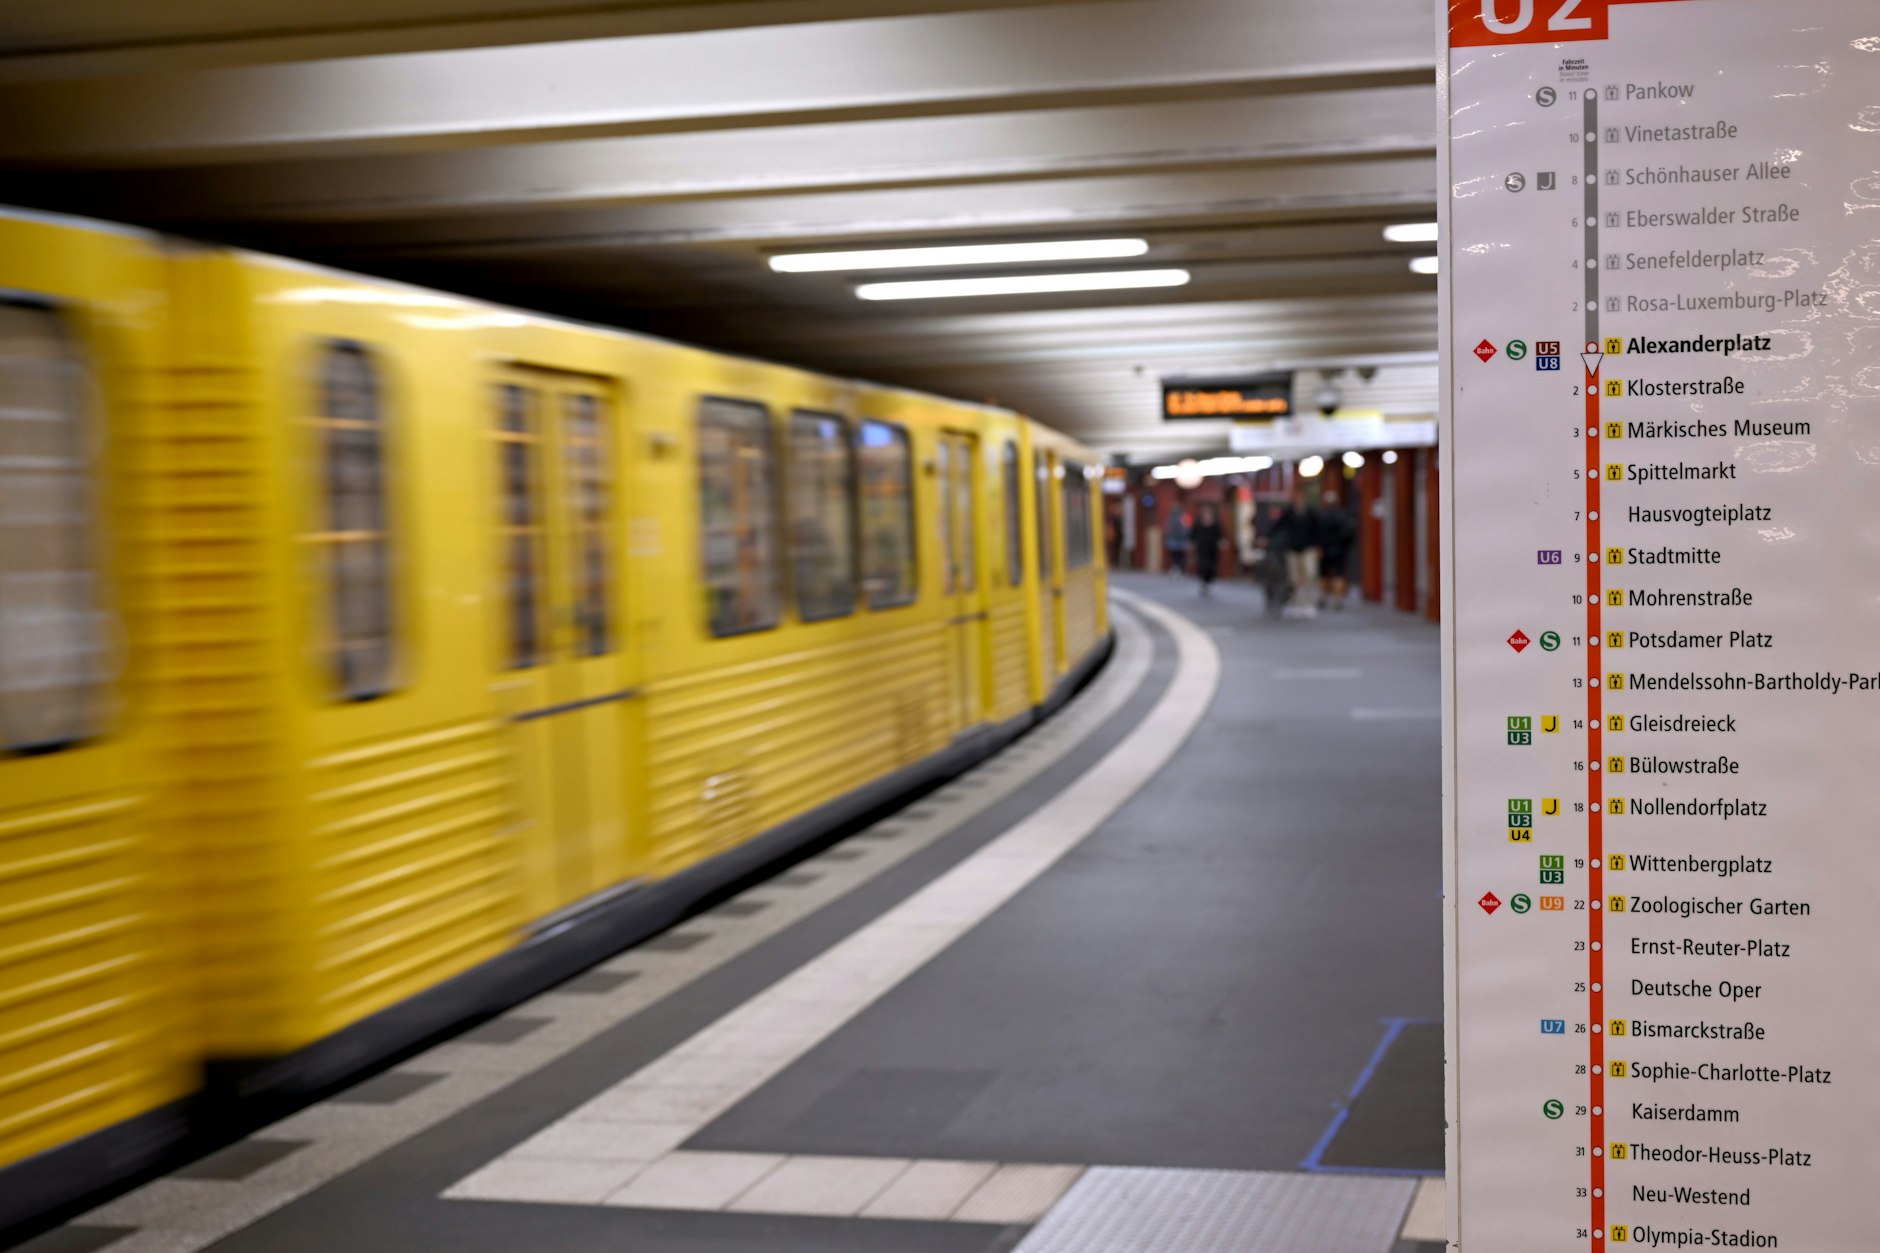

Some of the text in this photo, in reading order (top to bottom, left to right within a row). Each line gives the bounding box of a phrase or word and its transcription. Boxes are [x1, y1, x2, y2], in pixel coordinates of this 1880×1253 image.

[1569, 91, 1576, 100] 11
[1627, 81, 1694, 99] Pankow
[1625, 121, 1737, 142] Vinetastraße
[1569, 133, 1579, 143] 10
[1626, 162, 1790, 185] Schönhauser Allee
[1572, 176, 1577, 185] 8
[1628, 204, 1799, 227] Eberswalder Straße
[1572, 218, 1578, 227] 6
[1572, 260, 1578, 269] 4
[1627, 248, 1764, 271] Senefelderplatz
[1628, 289, 1827, 312] Rosa-Luxemburg-Platz
[1573, 302, 1578, 311] 2
[1539, 343, 1557, 354] U5
[1627, 334, 1770, 356] Alexanderplatz
[1539, 358, 1557, 369] U8
[1573, 386, 1578, 395] 2
[1629, 376, 1744, 396] Klosterstraße
[1574, 428, 1579, 437] 3
[1629, 420, 1810, 438] Märkisches Museum
[1574, 470, 1579, 479] 5
[1628, 462, 1735, 485] Spittelmarkt
[1575, 512, 1579, 520] 7
[1629, 504, 1771, 526] Hausvogteiplatz
[1540, 552, 1559, 563] U6
[1575, 554, 1580, 562] 9
[1629, 547, 1720, 564] Stadtmitte
[1573, 595, 1582, 604] 10
[1630, 588, 1752, 606] Mohrenstraße
[1573, 637, 1580, 645] 11
[1630, 630, 1772, 647] Potsdamer Platz
[1573, 679, 1582, 687] 13
[1510, 718, 1528, 729] U1
[1574, 720, 1582, 728] 14
[1630, 714, 1735, 731] Gleisdreieck
[1510, 733, 1529, 744] U3
[1574, 762, 1583, 770] 16
[1631, 756, 1738, 773] Bülowstraße
[1511, 800, 1529, 811] U1
[1574, 803, 1583, 812] 18
[1631, 798, 1766, 820] Nollendorfplatz
[1511, 815, 1530, 826] U3
[1512, 830, 1530, 840] U4
[1543, 856, 1560, 868] U1
[1575, 859, 1583, 868] 19
[1630, 855, 1771, 877] Wittenbergplatz
[1543, 871, 1561, 883] U3
[1543, 898, 1561, 909] U9
[1574, 900, 1584, 909] 22
[1631, 896, 1809, 918] Zoologischer Garten
[1575, 942, 1584, 950] 23
[1632, 938, 1789, 957] Ernst-Reuter-Platz
[1575, 983, 1585, 992] 25
[1632, 980, 1761, 1002] Deutsche Oper
[1544, 1021, 1562, 1033] U7
[1575, 1024, 1585, 1033] 26
[1633, 1021, 1764, 1040] Bismarckstraße
[1576, 1065, 1586, 1074] 28
[1632, 1062, 1830, 1083] Sophie-Charlotte-Platz
[1576, 1106, 1586, 1115] 29
[1633, 1103, 1738, 1122] Kaiserdamm
[1576, 1147, 1584, 1156] 31
[1630, 1144, 1811, 1166] Theodor-Heuss-Platz
[1577, 1188, 1586, 1197] 33
[1634, 1186, 1749, 1205] Neu-Westend
[1577, 1229, 1587, 1238] 34
[1634, 1226, 1777, 1248] Olympia-Stadion
